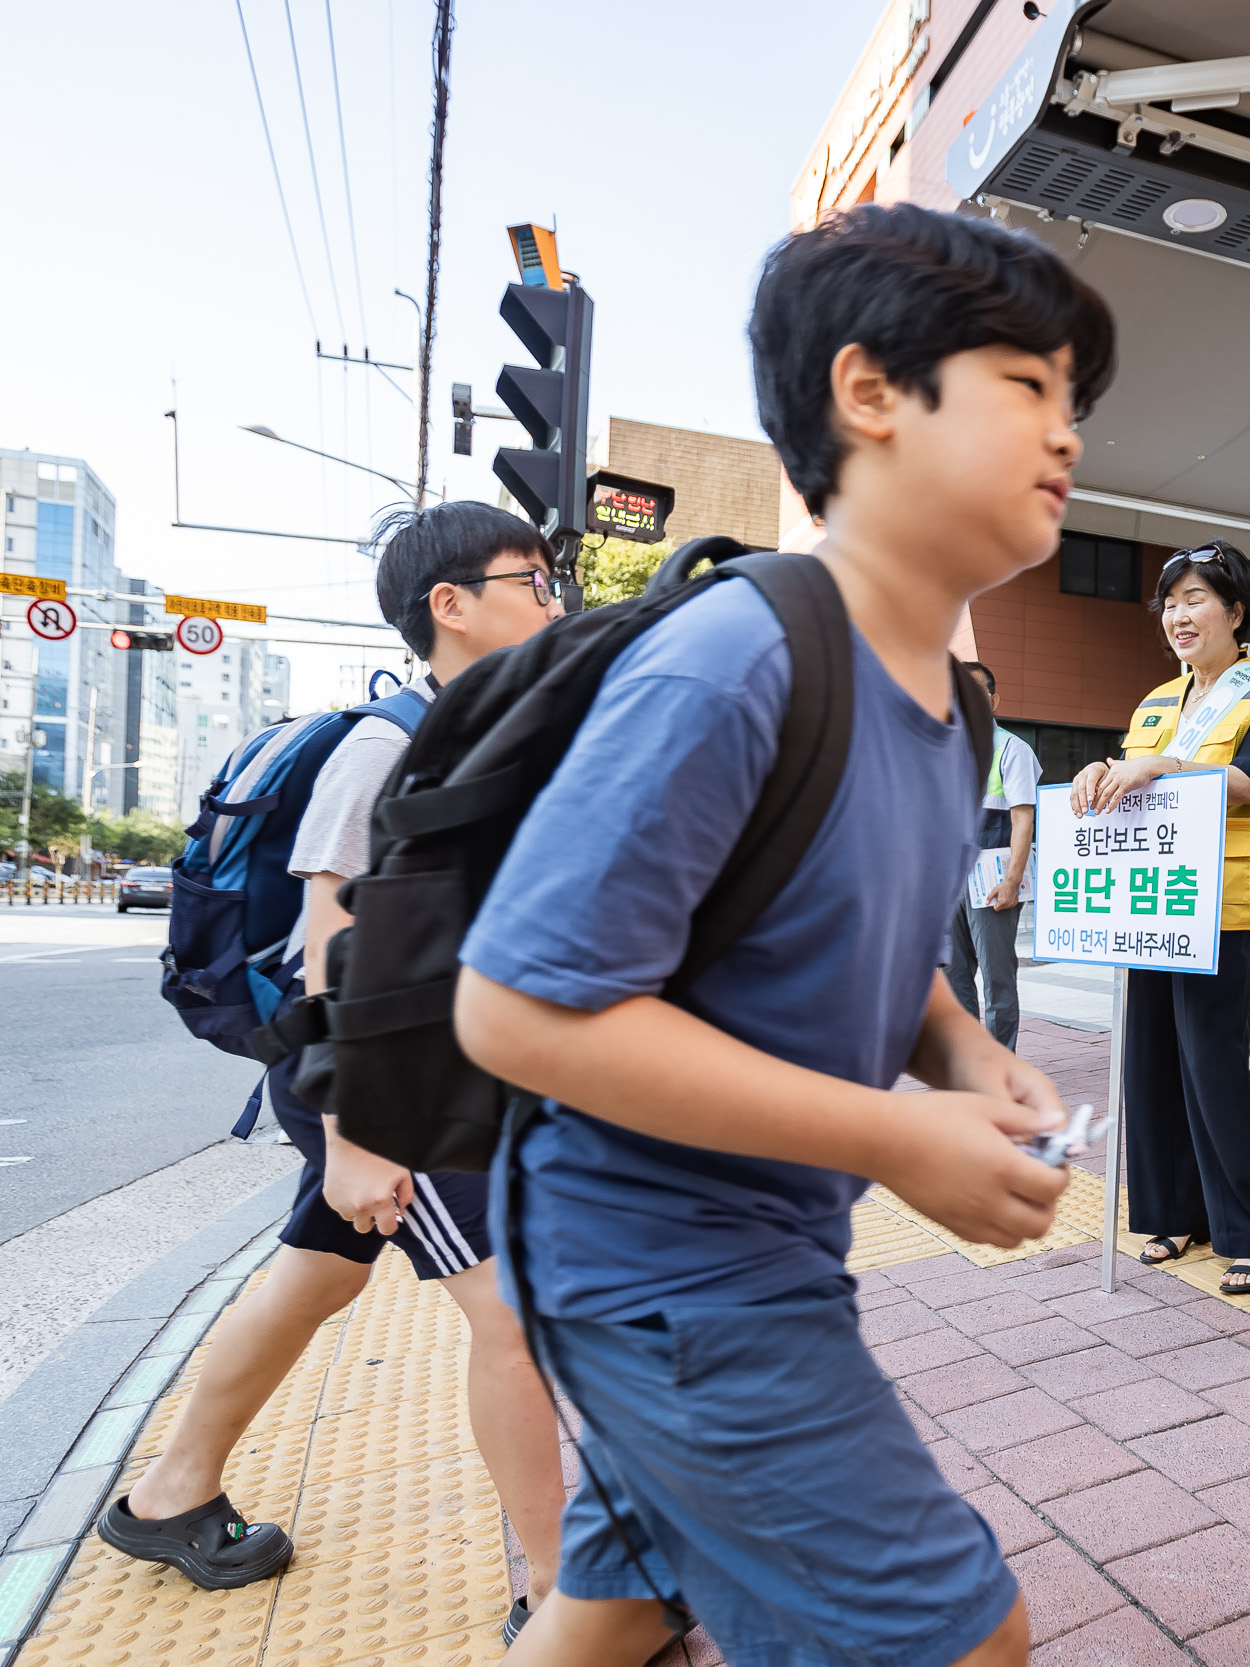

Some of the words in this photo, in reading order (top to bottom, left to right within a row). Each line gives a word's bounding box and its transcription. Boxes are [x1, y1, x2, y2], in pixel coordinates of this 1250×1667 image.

[187, 625, 214, 643] 50
[1181, 706, 1217, 749] 아이
[1146, 791, 1178, 810] 캠페인
[1074, 826, 1150, 857] 횡단보도
[1157, 823, 1177, 854] 앞
[1053, 868, 1116, 913] 일단
[1129, 865, 1198, 916] 멈춤
[1048, 928, 1074, 952] 아이
[1080, 929, 1107, 954] 먼저
[1112, 931, 1196, 959] 보내주세요.
